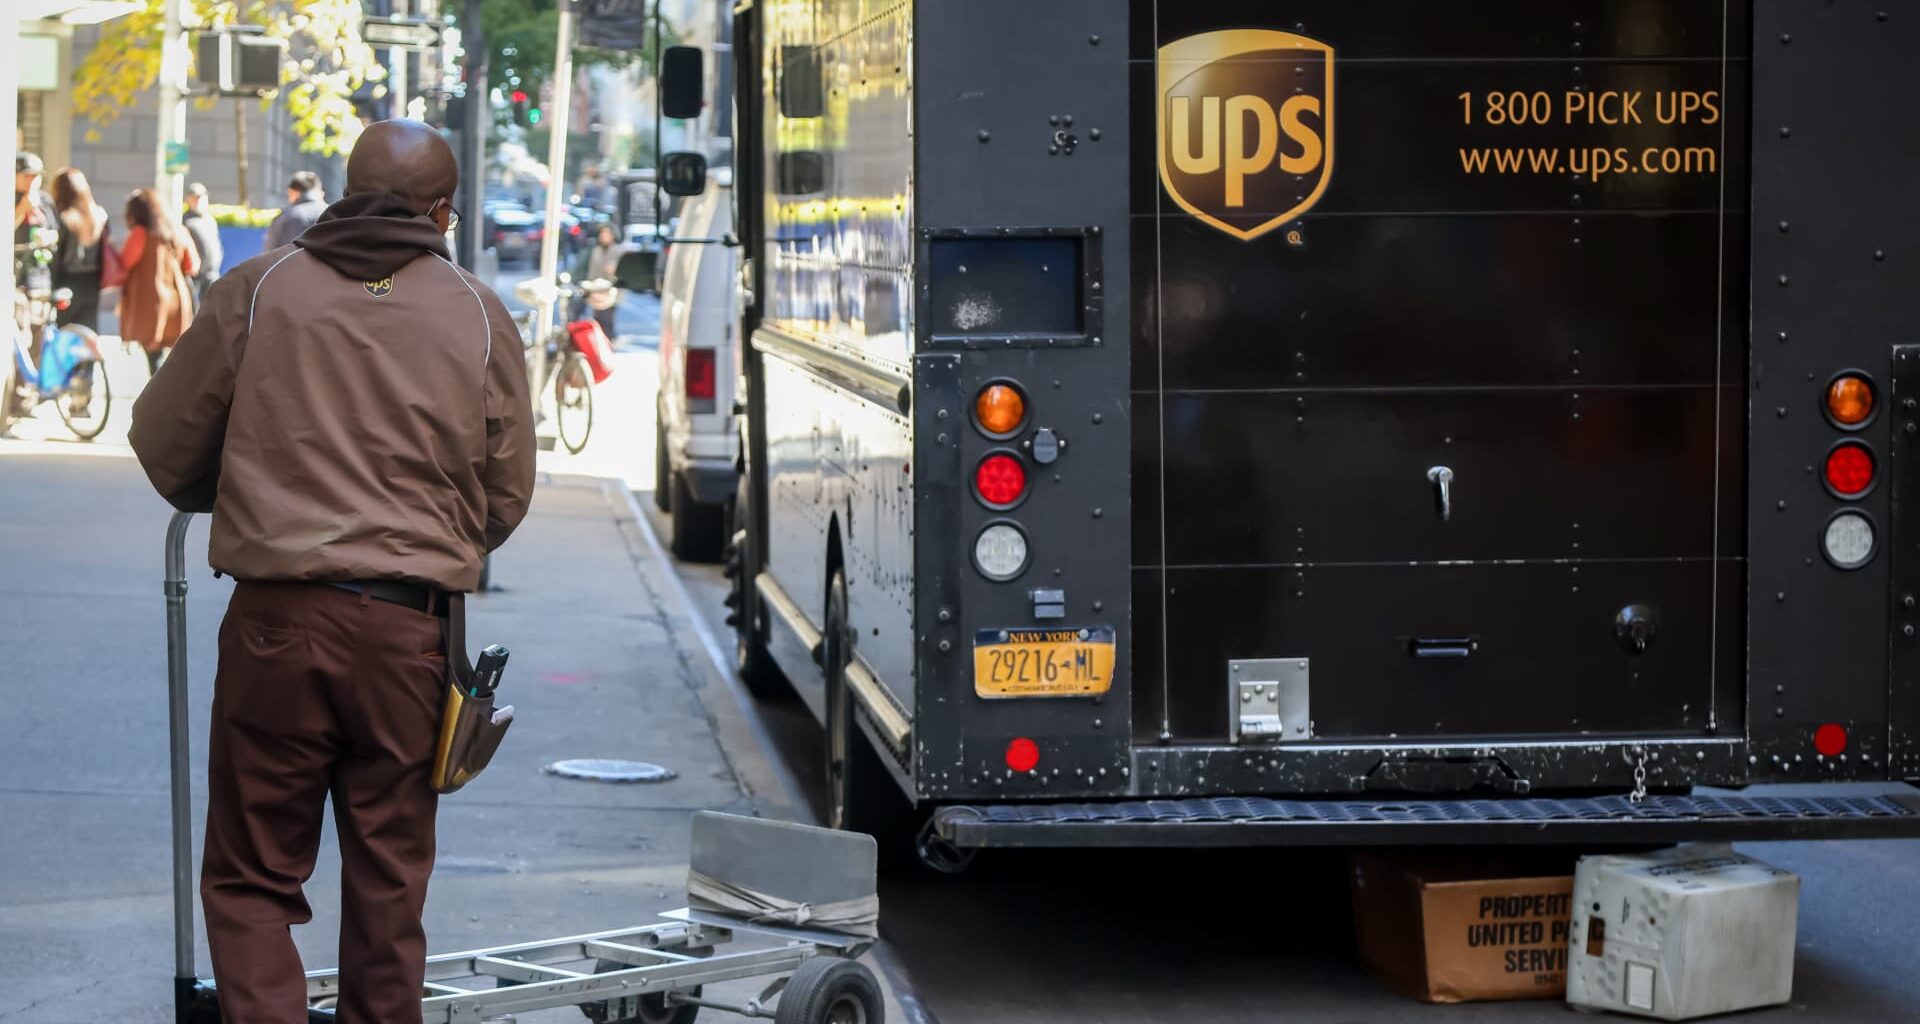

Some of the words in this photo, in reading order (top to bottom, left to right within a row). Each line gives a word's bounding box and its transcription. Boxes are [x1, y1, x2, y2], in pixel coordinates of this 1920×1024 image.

[1459, 91, 1471, 124] 1
[1486, 91, 1551, 125] 800
[1565, 91, 1642, 124] PICK
[1655, 91, 1719, 125] UPS
[1171, 95, 1322, 207] ups
[1459, 147, 1716, 182] www.ups.com
[1009, 632, 1042, 643] NEW
[1045, 631, 1080, 642] YORK
[1479, 892, 1571, 919] PROPERT
[1468, 922, 1544, 947] UNITED
[1505, 948, 1569, 973] SERVI
